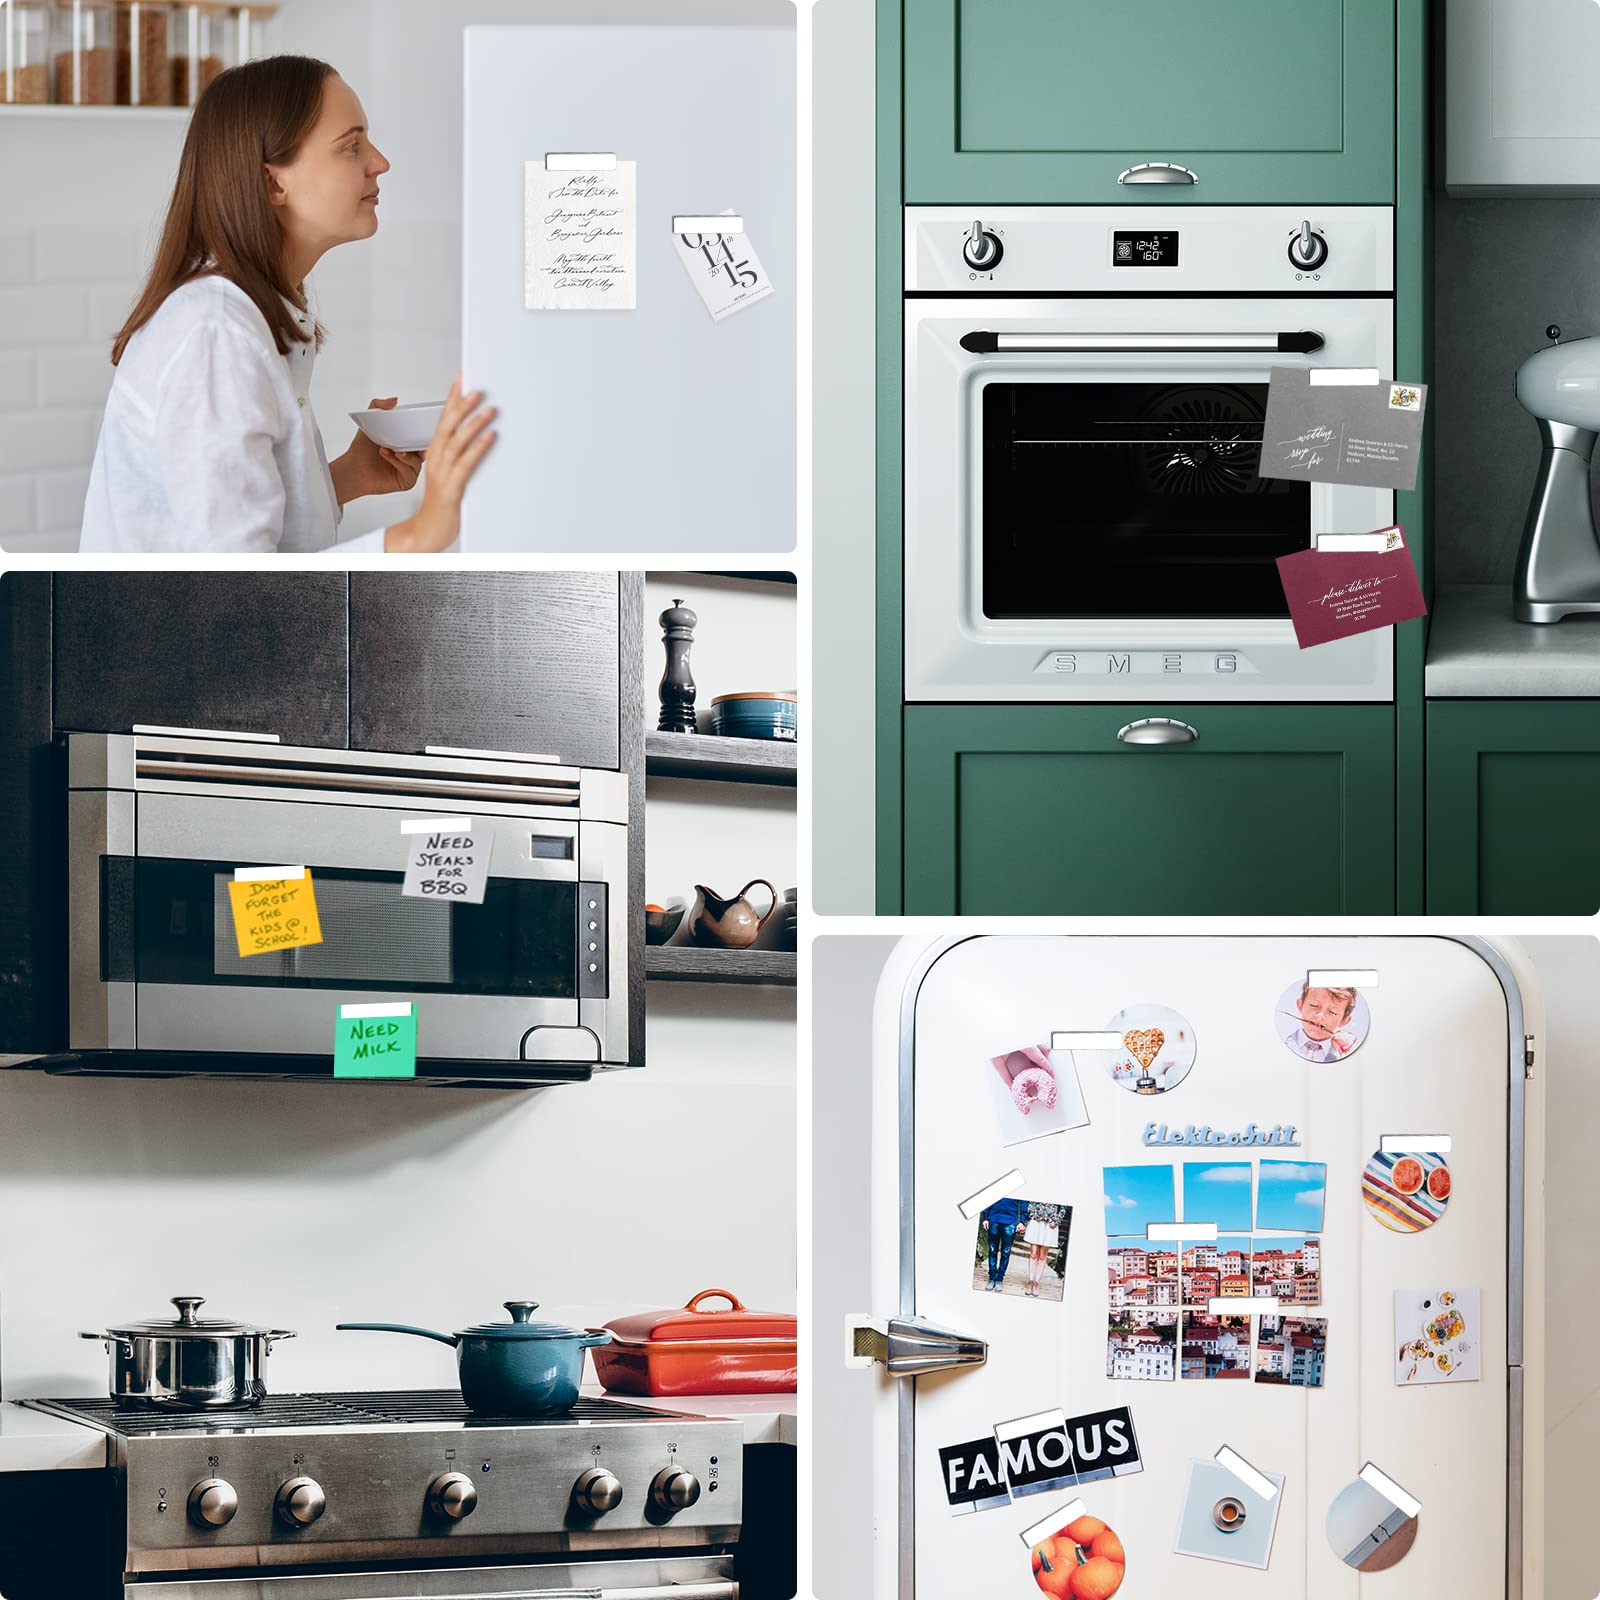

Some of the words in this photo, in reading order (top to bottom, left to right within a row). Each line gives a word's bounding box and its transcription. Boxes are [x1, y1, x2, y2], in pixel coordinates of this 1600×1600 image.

[1054, 653, 1237, 673] SMEG
[426, 832, 474, 850] NEED
[415, 853, 474, 867] STEAKS
[437, 867, 463, 878] FOR
[420, 880, 468, 895] BBQ
[245, 888, 299, 911] FORGET
[257, 908, 282, 922] THE
[249, 922, 282, 936] KIDS
[350, 1019, 399, 1040] NEED
[353, 1041, 401, 1060] MILK
[948, 1419, 1130, 1494] FAMOUS
